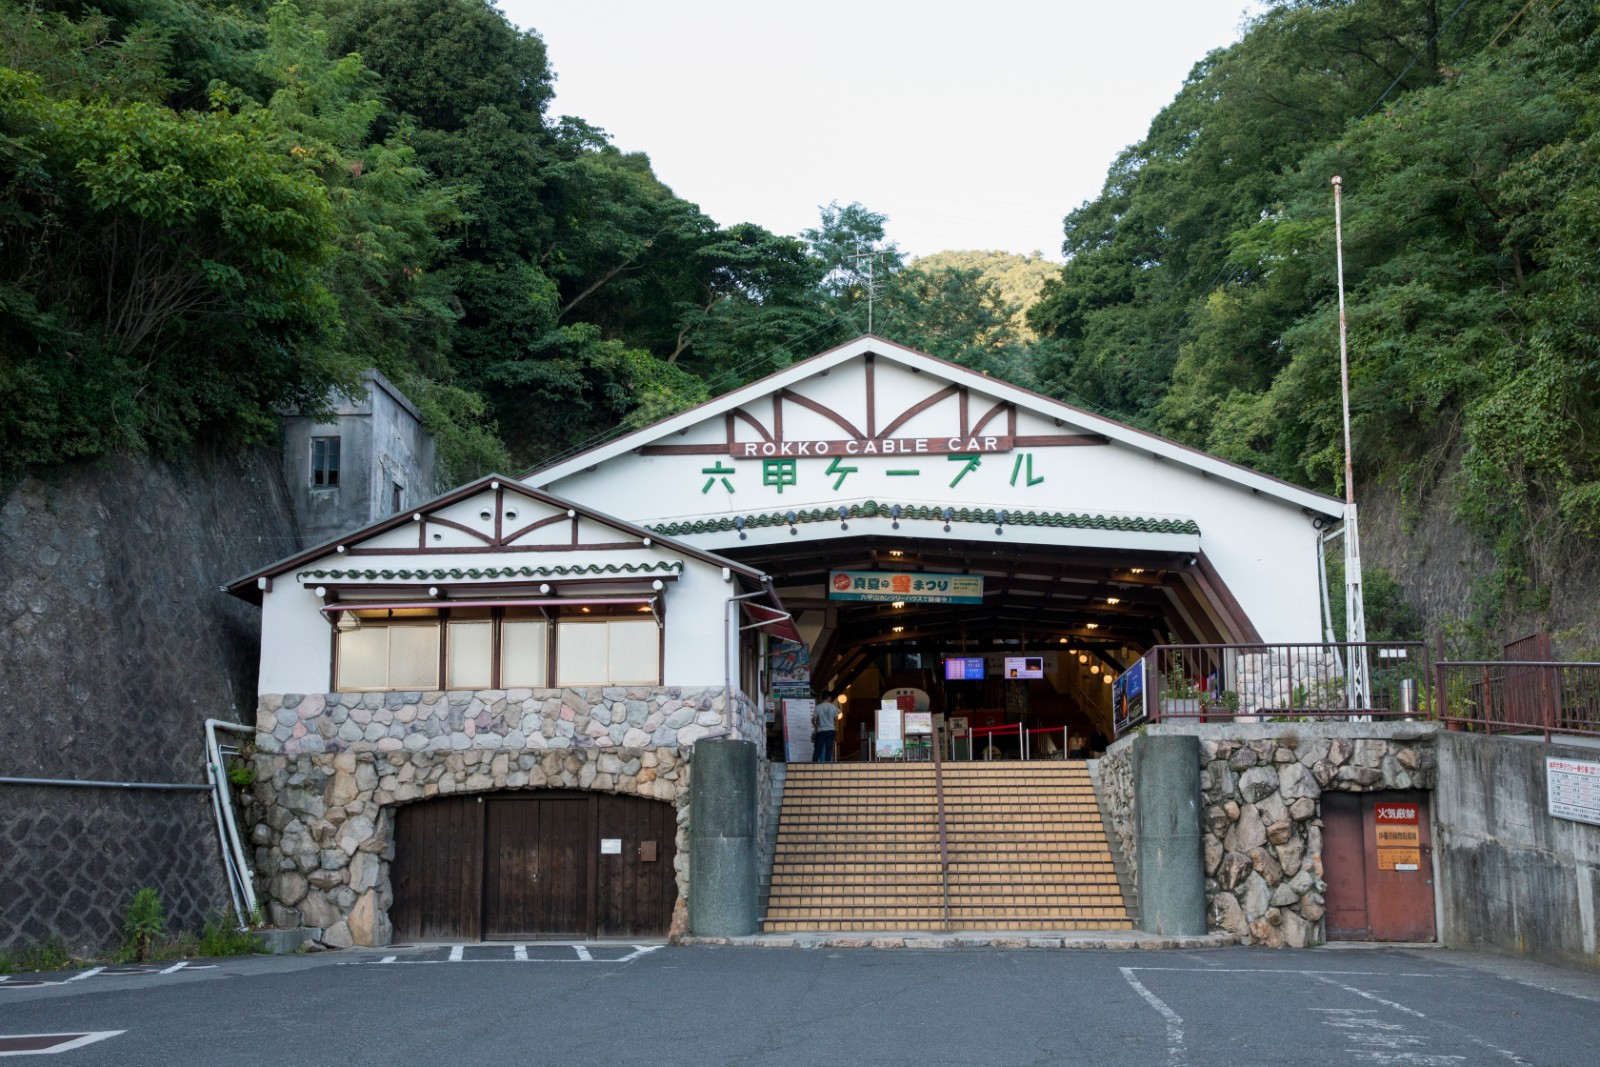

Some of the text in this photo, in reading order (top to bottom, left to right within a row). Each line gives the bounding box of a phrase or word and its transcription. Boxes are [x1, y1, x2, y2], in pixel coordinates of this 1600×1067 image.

[745, 436, 998, 456] ROKKO CABLE CAR
[702, 453, 1044, 494] 六甲ケーブル
[853, 575, 949, 593] 真夏の雪まつり
[1378, 807, 1416, 819] 火気厳禁
